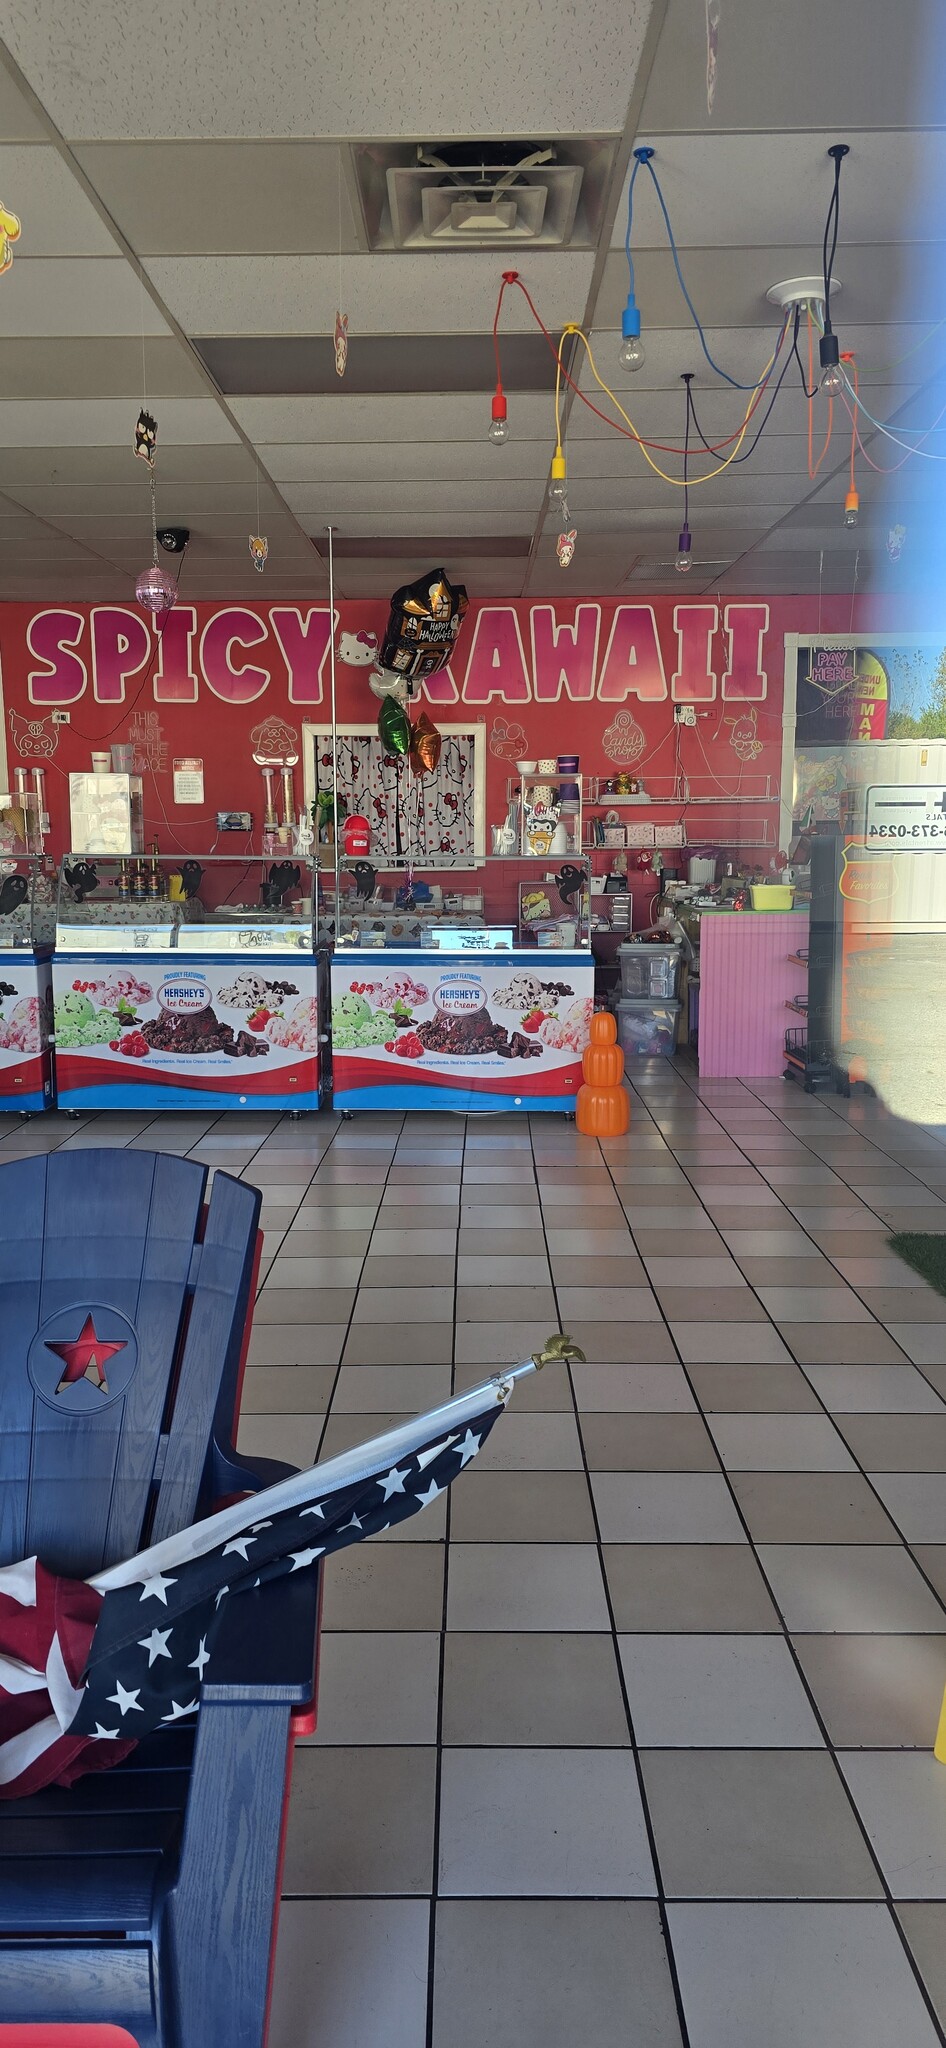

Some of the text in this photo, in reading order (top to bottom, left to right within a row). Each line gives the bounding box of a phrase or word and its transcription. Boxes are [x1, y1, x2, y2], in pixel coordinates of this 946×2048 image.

[430, 621, 450, 631] HAPPY
[419, 630, 455, 642] HALLOWEEN
[26, 607, 339, 704] SPICY
[817, 652, 847, 666] PAY
[812, 667, 854, 682] HERE
[131, 711, 159, 727] THIS
[129, 729, 162, 741] MUST
[601, 731, 643, 748] Candy
[143, 743, 169, 756] THE
[164, 971, 206, 980] PROUDLY FEATURING
[440, 973, 481, 982] PROUDLY FEATURING
[164, 988, 205, 997] HERSHEY'S
[440, 990, 480, 999] HERSHEY'S
[167, 998, 203, 1007] Ice Cream
[443, 1000, 478, 1008] Ice Cream
